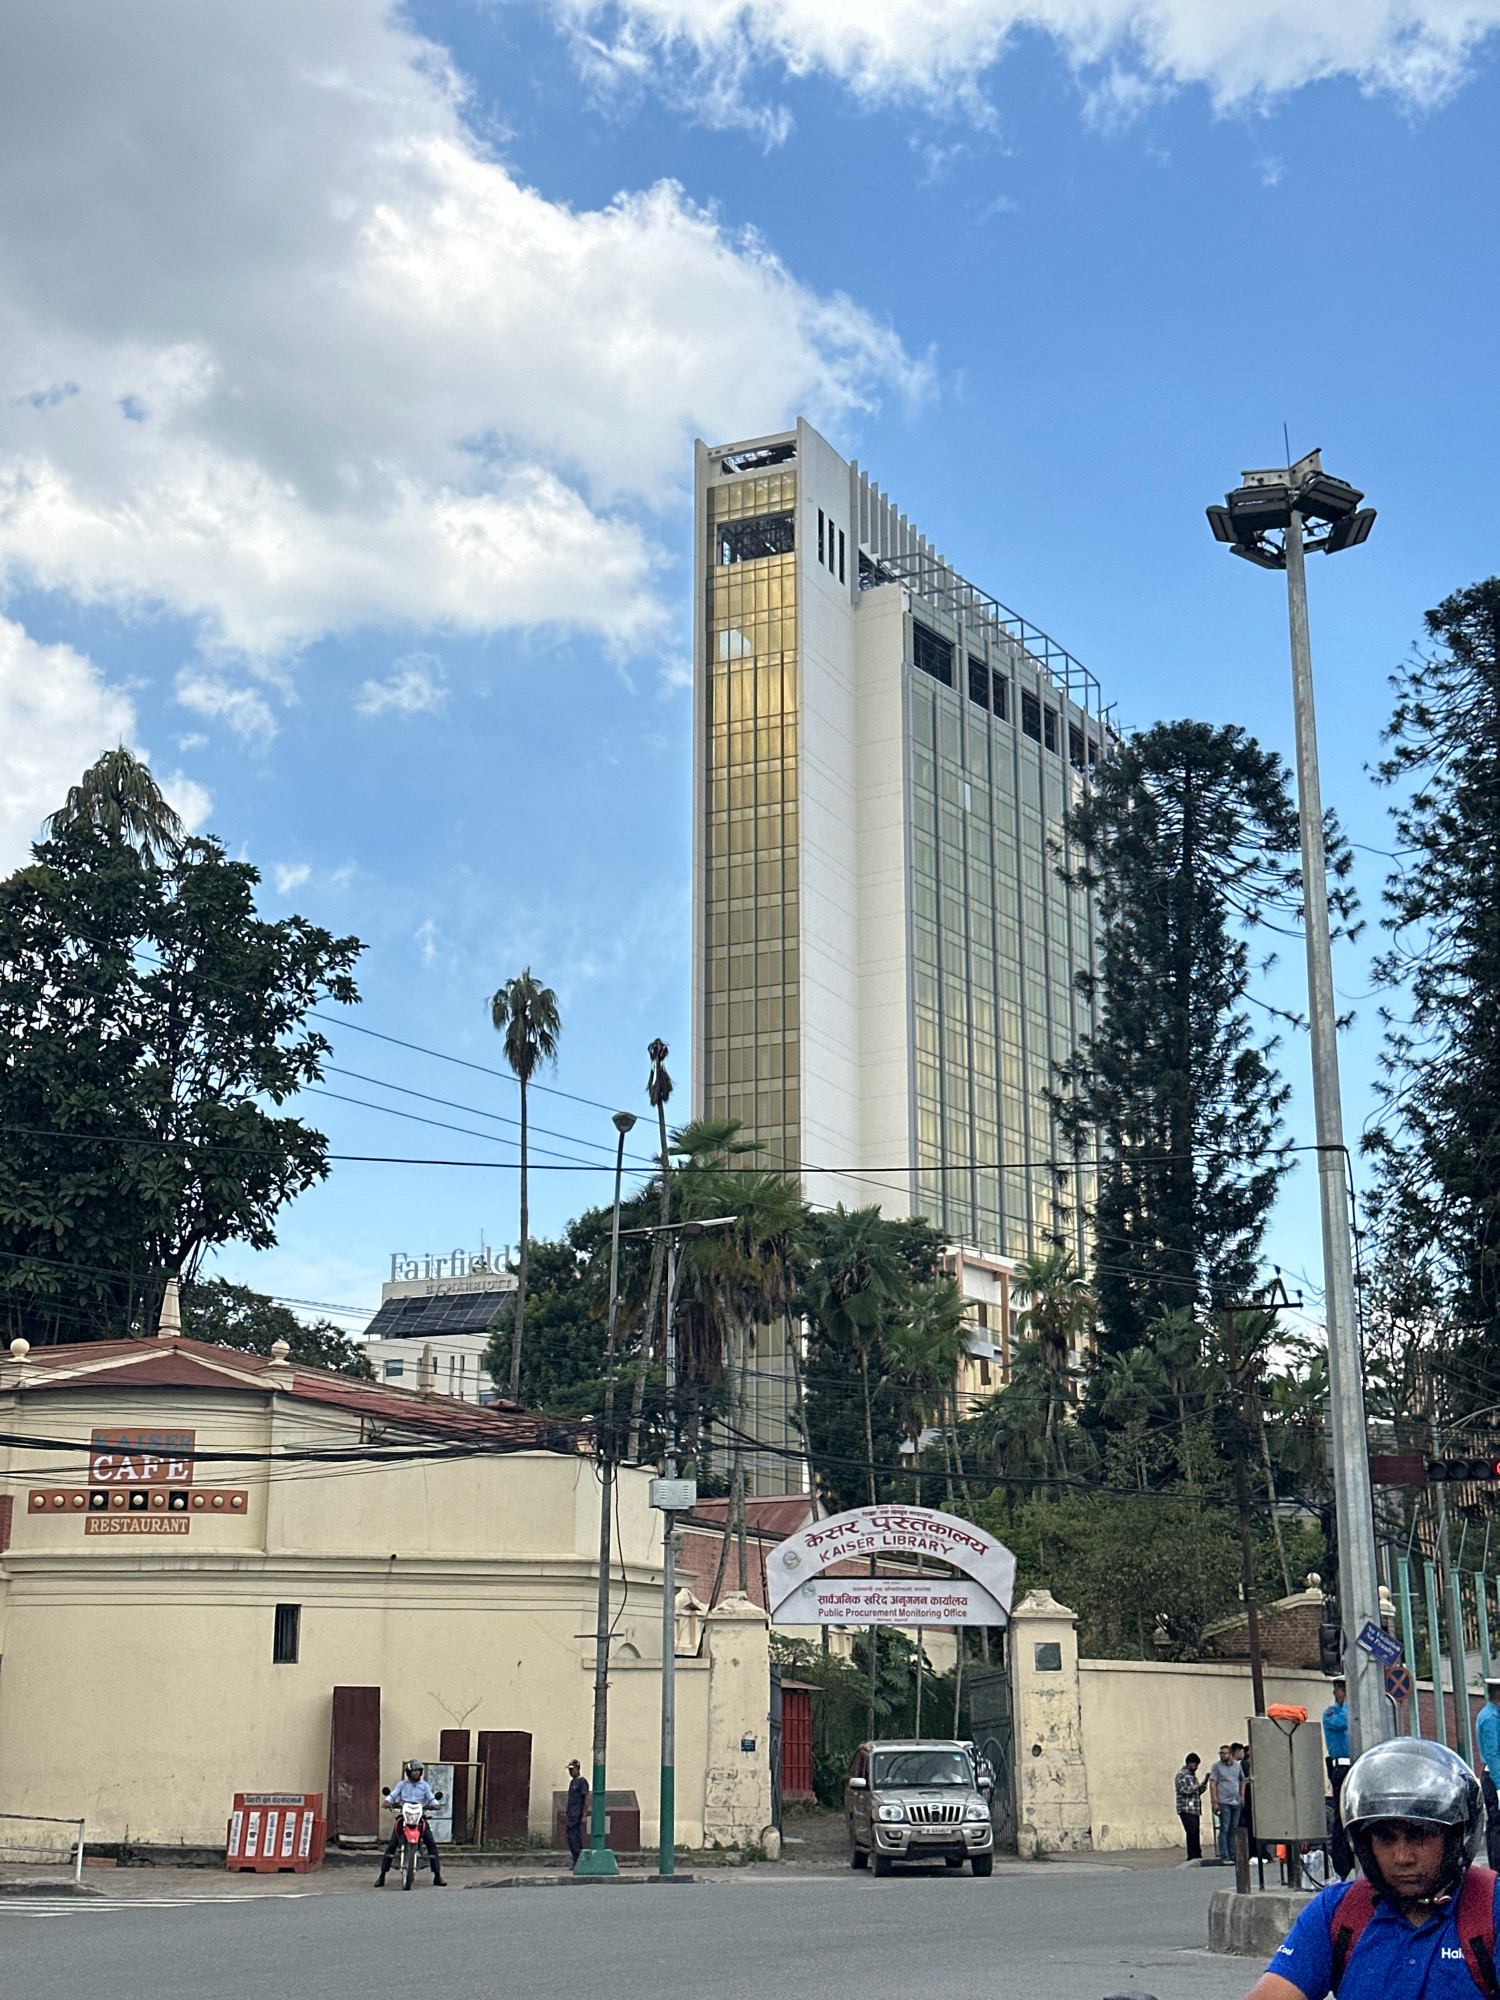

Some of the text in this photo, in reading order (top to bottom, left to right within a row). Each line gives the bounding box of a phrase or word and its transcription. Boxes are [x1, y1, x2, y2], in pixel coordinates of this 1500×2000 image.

[390, 1245, 510, 1282] Fairfield
[446, 1279, 512, 1293] MARRIOTT
[94, 1433, 192, 1451] KAISER
[93, 1454, 190, 1481] CAFE
[90, 1518, 188, 1533] RESTAURANT
[805, 1516, 990, 1556] केसर पुस्तकालय
[819, 1536, 875, 1563] KAISER
[883, 1535, 955, 1555] LIBRARY
[817, 1592, 968, 1608] सार्वजनिक खरिद अनुगमन कार्यालय
[818, 1608, 967, 1619] Public Procurement Monitoring Office
[1374, 1638, 1395, 1656] Penalty
[1376, 1631, 1401, 1652] Violation
[1441, 1947, 1465, 1960] Hal
